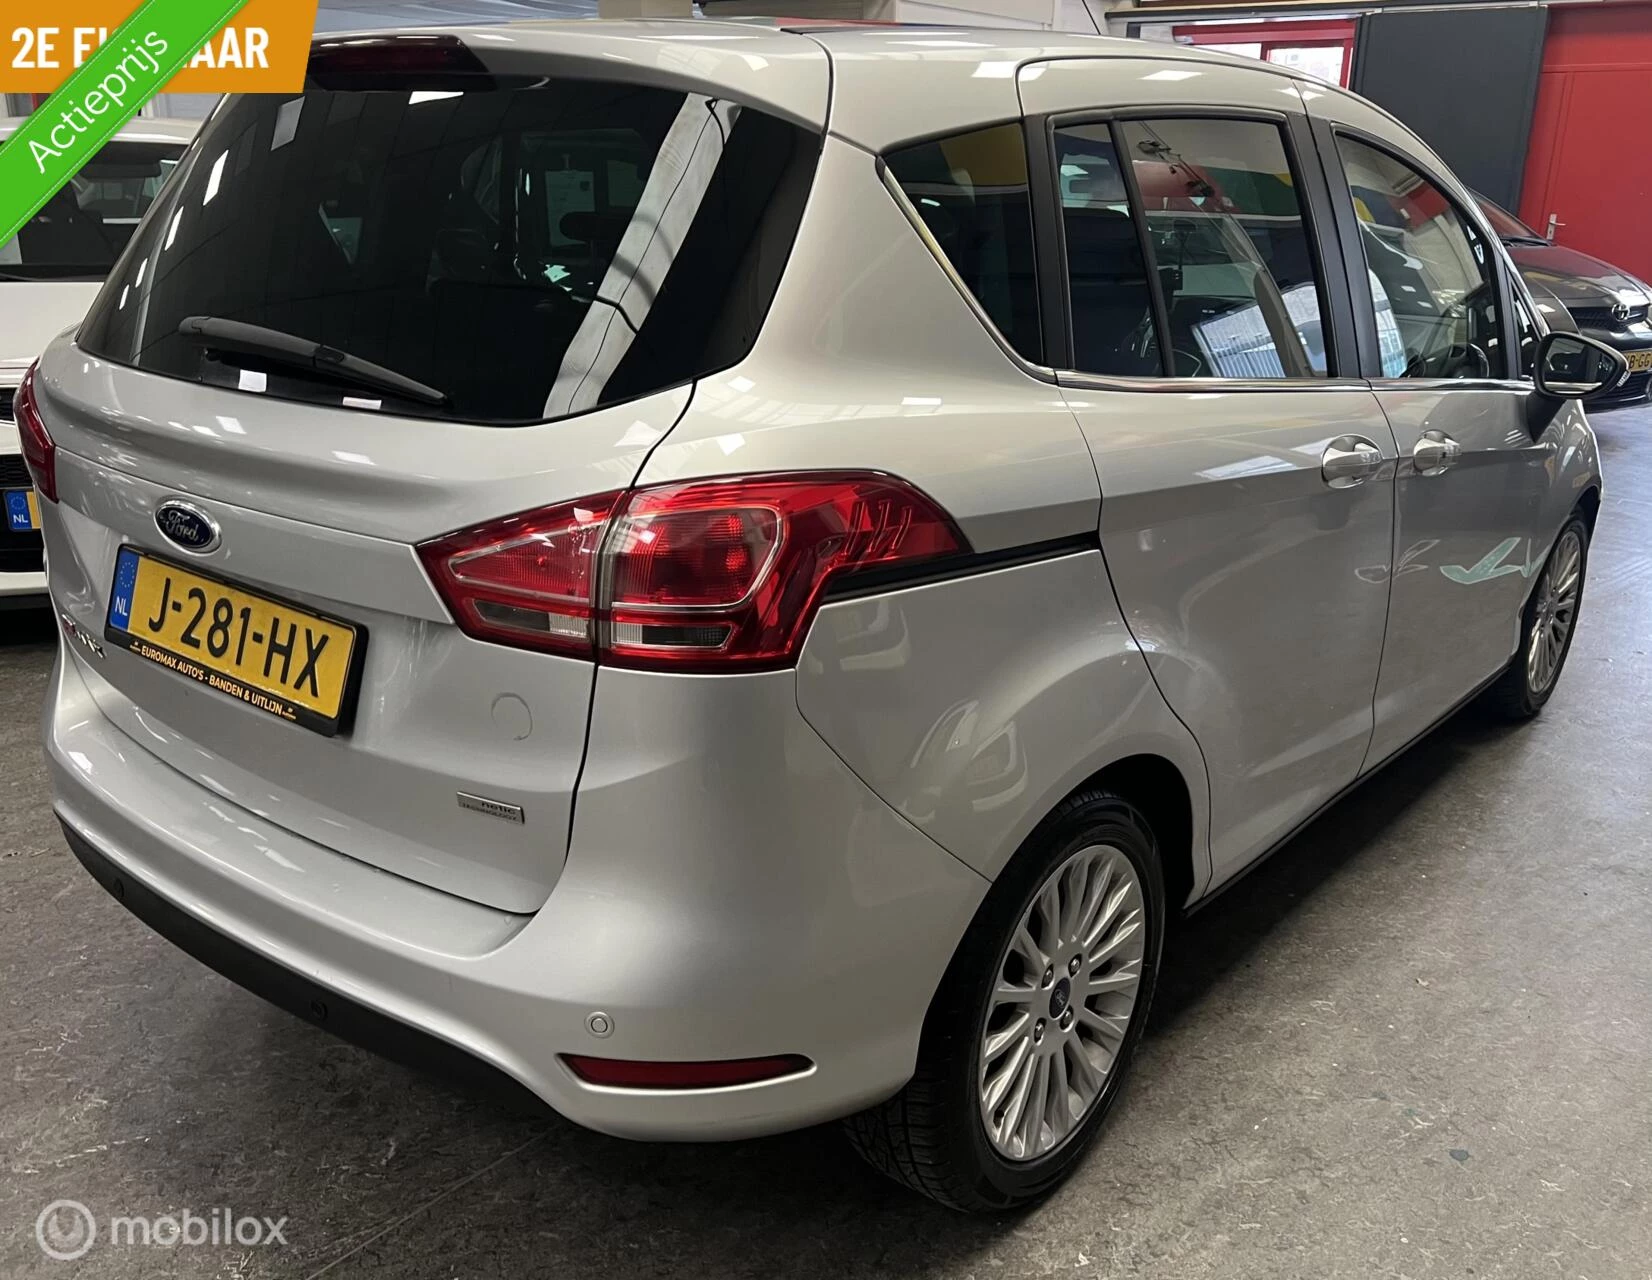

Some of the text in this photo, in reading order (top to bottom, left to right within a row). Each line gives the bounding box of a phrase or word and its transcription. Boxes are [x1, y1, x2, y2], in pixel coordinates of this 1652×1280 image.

[13, 514, 29, 524] NL
[164, 509, 200, 543] Ford
[114, 597, 129, 617] NL
[147, 577, 330, 698] J-281-HX
[141, 645, 177, 669] EUROMAX
[177, 661, 204, 681] AUTO'S
[209, 674, 243, 698] BANDEN
[243, 689, 250, 702] &
[251, 692, 283, 715] UITLIJN
